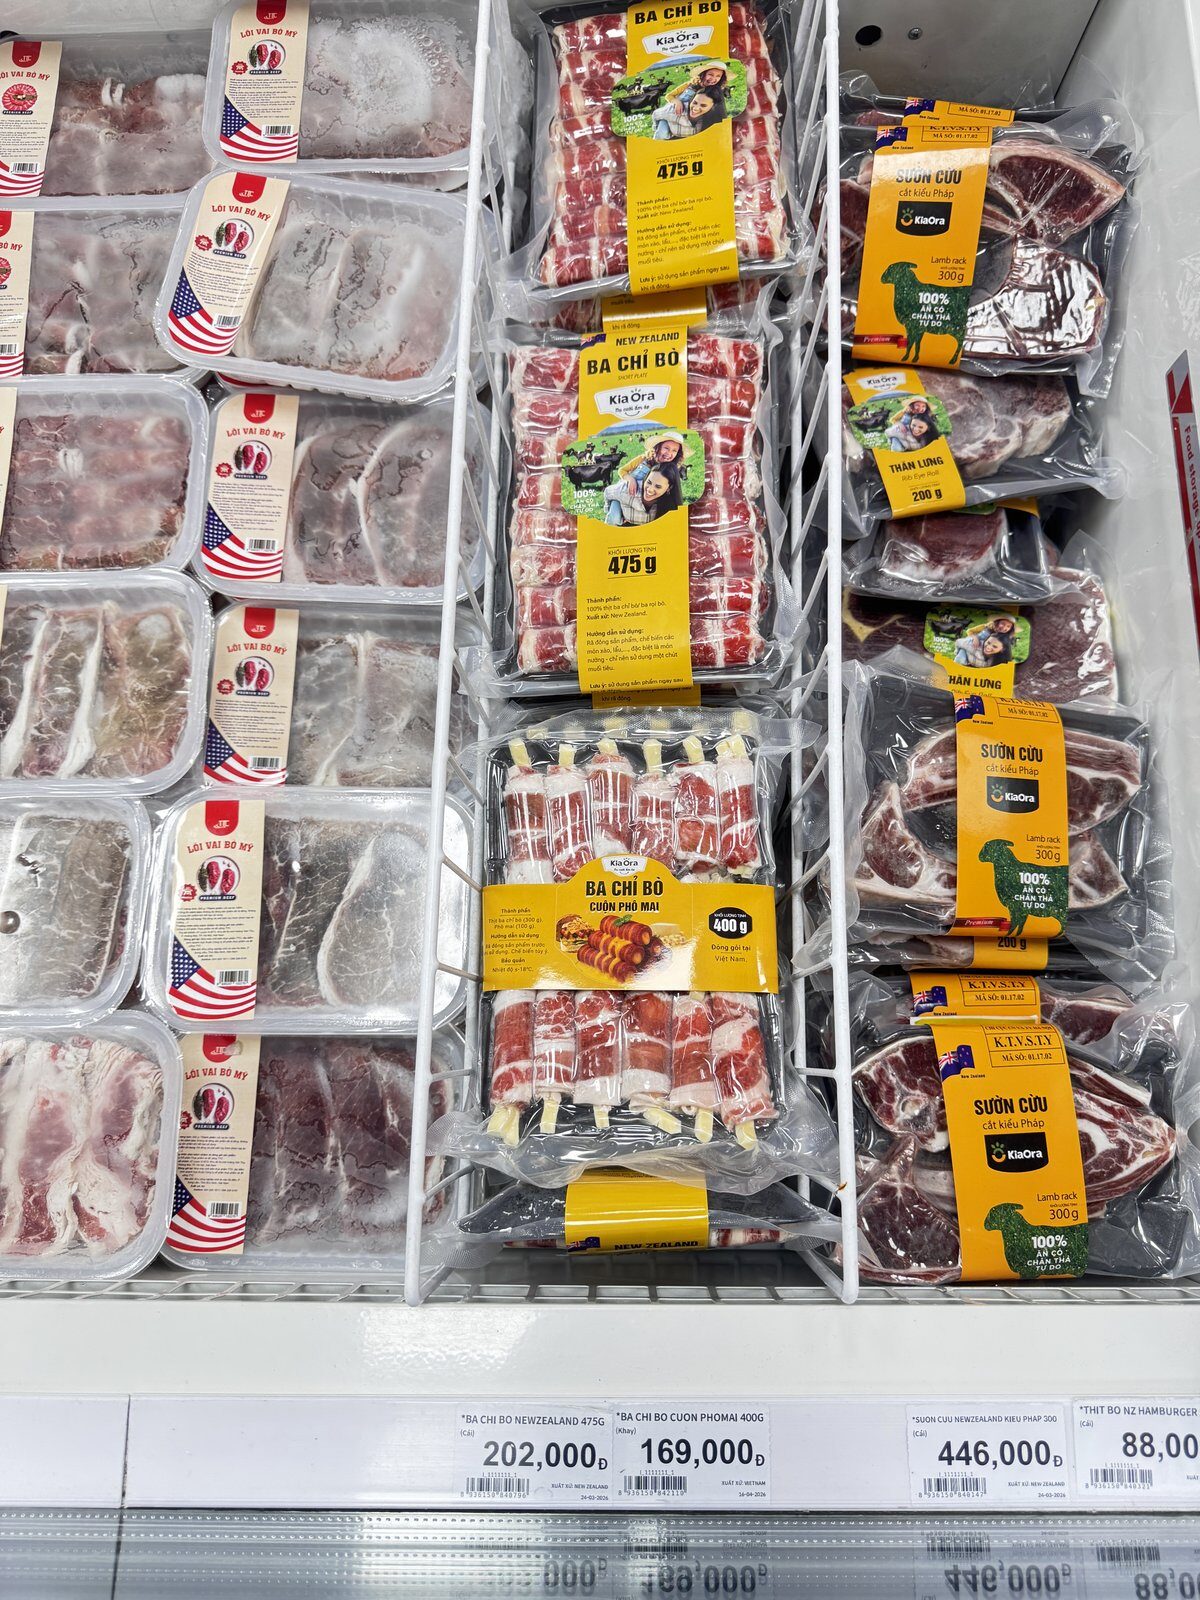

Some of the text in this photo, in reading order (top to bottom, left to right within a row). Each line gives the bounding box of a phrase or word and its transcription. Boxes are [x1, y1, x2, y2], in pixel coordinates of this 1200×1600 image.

[635, 10, 658, 24] BA
[657, 160, 703, 179] 475 g
[935, 167, 962, 184] CỪU
[913, 187, 931, 197] kiểu
[933, 188, 954, 199] Pháp
[228, 205, 243, 214] VAI
[914, 215, 945, 225] KiaOra
[931, 256, 967, 264] Lamb rack
[918, 292, 950, 305] 100%
[616, 332, 679, 346] NEW ZEALAND
[587, 348, 679, 375] BA CHỈ BÒ
[917, 456, 944, 468] LƯNG
[1184, 425, 1200, 518] Food storage
[912, 488, 943, 502] 200 g
[608, 554, 657, 575] 475 g
[981, 742, 1043, 762] SƯỜN CỪU
[1000, 764, 1017, 774] kiểu
[1019, 765, 1039, 777] Pháp
[1005, 792, 1035, 803] KiaOra
[205, 841, 221, 849] VAI
[1026, 834, 1061, 844] Lamb rack
[1019, 872, 1050, 885] 100%
[586, 875, 664, 896] BA CHỈ BÒ
[589, 900, 659, 913] CUỘN PHÔ MAI
[714, 918, 748, 934] 400 g
[997, 936, 1027, 950] 200 g
[968, 981, 1026, 989] K.T.V.S.T.Y
[994, 1035, 1052, 1048] K.T.V.S.T.Y
[1028, 1053, 1052, 1061] 01.17.02
[202, 1068, 217, 1076] VAI
[974, 1094, 1048, 1115] SƯỜN CỪU
[983, 1118, 1044, 1130] cắt kiểu Pháp
[1008, 1149, 1043, 1160] KiaOra
[1037, 1192, 1078, 1202] Lamb rack
[646, 1240, 698, 1248] ZEALAND
[1031, 1234, 1067, 1249] 100%
[635, 1413, 652, 1421] CHI
[654, 1413, 668, 1421] BO
[670, 1413, 698, 1422] CUON
[700, 1413, 738, 1422] PHOMAI
[740, 1413, 764, 1422] 400G
[1107, 1406, 1121, 1414] BO
[1123, 1407, 1136, 1415] NZ
[1138, 1407, 1197, 1417] HAMBURGER
[480, 1415, 496, 1424] CHI
[499, 1415, 512, 1424] BO
[515, 1415, 579, 1425] NEWZEALAND
[581, 1417, 605, 1426] 475G
[937, 1415, 953, 1423] CUU
[954, 1415, 1003, 1423] NEWZEALAND
[1004, 1415, 1021, 1423] KIEU
[1023, 1414, 1042, 1423] PHAP
[1043, 1414, 1057, 1422] 300
[615, 1427, 637, 1436] (Khay)
